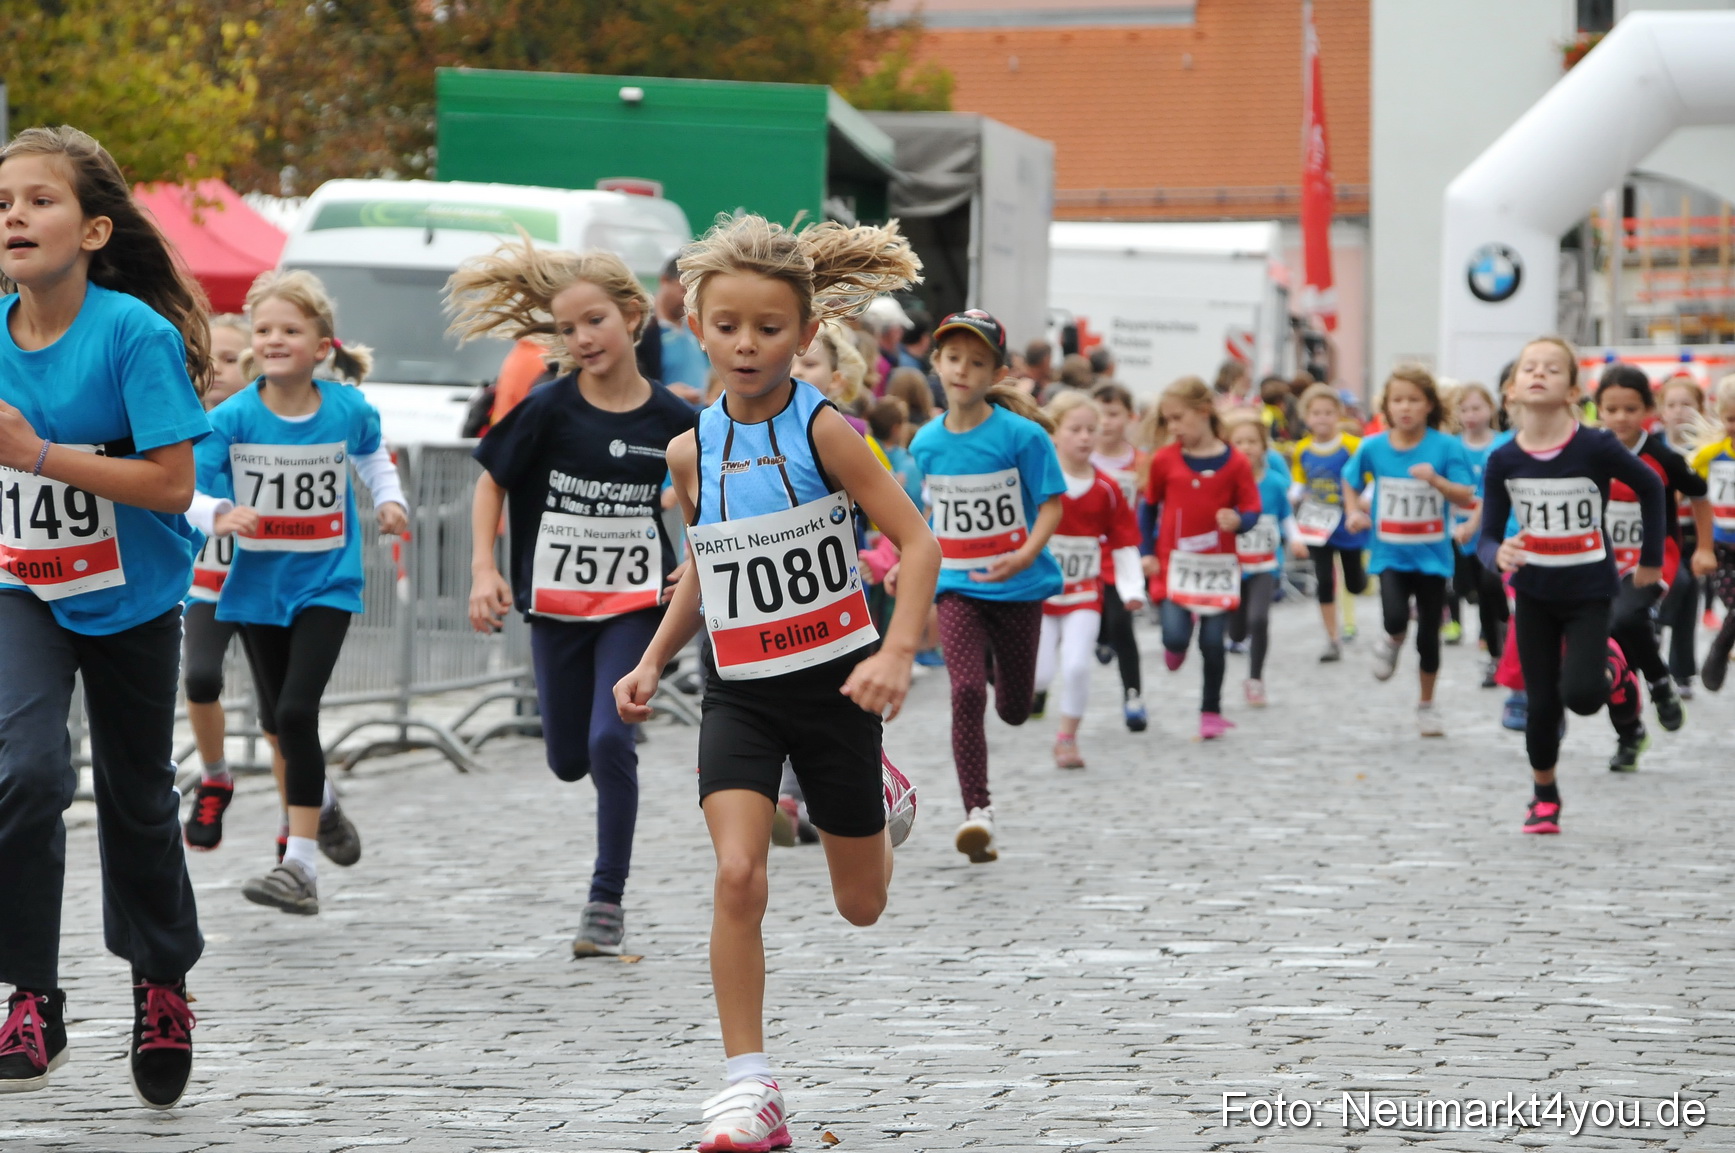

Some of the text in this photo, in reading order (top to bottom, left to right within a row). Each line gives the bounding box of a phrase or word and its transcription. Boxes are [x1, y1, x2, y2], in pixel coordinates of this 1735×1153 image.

[233, 453, 330, 466] PARTL Neumarkt
[244, 470, 337, 511] 7183
[548, 469, 657, 503] GRUNDSCHULE
[0, 481, 99, 540] 149
[938, 493, 1016, 533] 7536
[1387, 493, 1438, 517] 7171
[1520, 498, 1593, 531] 7119
[264, 521, 316, 536] Kristin
[541, 523, 641, 539] PARTL Neumarkt
[695, 517, 826, 556] PARTL Neumarkt
[8, 556, 63, 579] Leoni
[549, 543, 649, 585] 7573
[712, 535, 848, 619] 7080
[1177, 567, 1233, 590] 7123
[712, 618, 719, 629] 3
[759, 620, 830, 653] Felina
